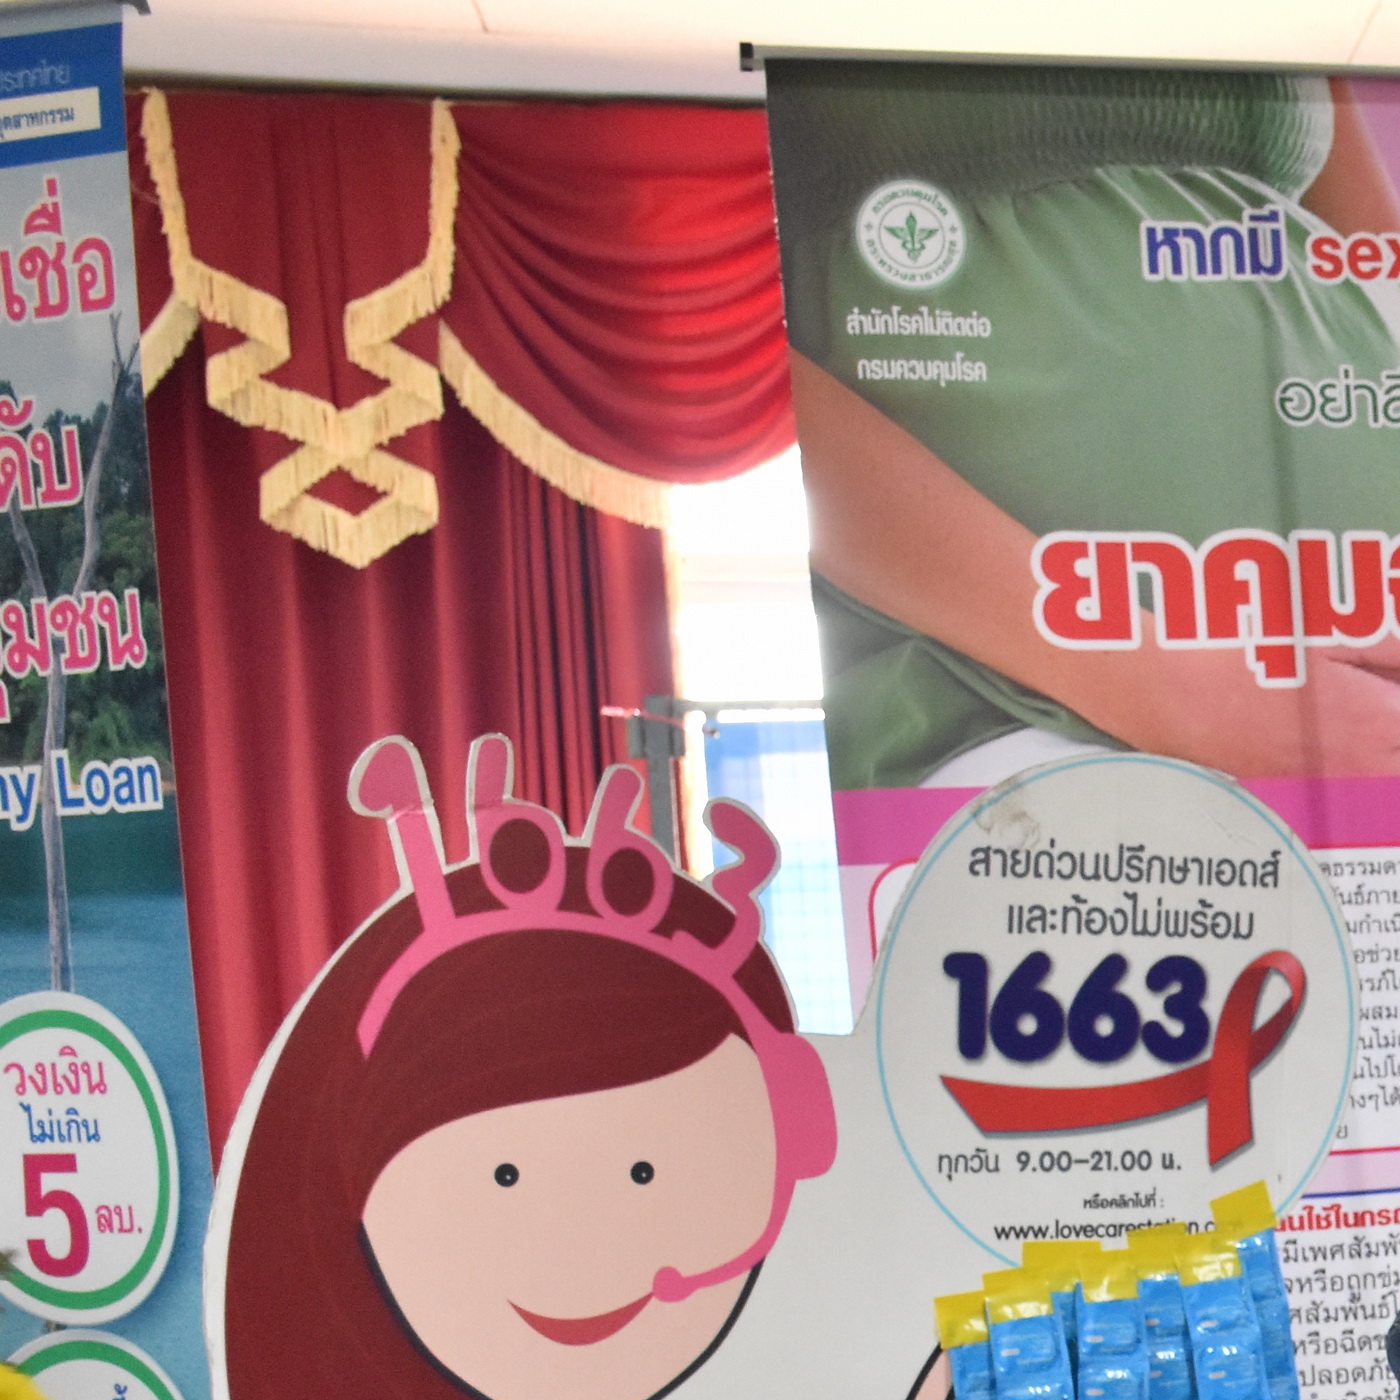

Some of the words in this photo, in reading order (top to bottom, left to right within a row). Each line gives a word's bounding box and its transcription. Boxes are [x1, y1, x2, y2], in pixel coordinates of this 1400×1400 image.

[1145, 211, 1285, 277] หากมี
[846, 304, 992, 338] สำนักโรคไม่ติดต่อ
[857, 352, 988, 387] กรมควบคุมโรค
[56, 755, 161, 810] Loan
[352, 735, 780, 978] 1663
[967, 838, 1283, 889] สายด่วนปรึกษาเอดส์
[1006, 893, 1255, 939] และท้องไม่พร้อม
[942, 950, 1211, 1063] 1663
[4, 1046, 108, 1096] วงเงิน
[20, 1102, 101, 1143] ไม่เกิน
[937, 1148, 1001, 1180] ทุกวัน
[1161, 1152, 1182, 1171] น.
[22, 1153, 90, 1277] 5
[1083, 1187, 1158, 1210] หรือคลิกไปที่
